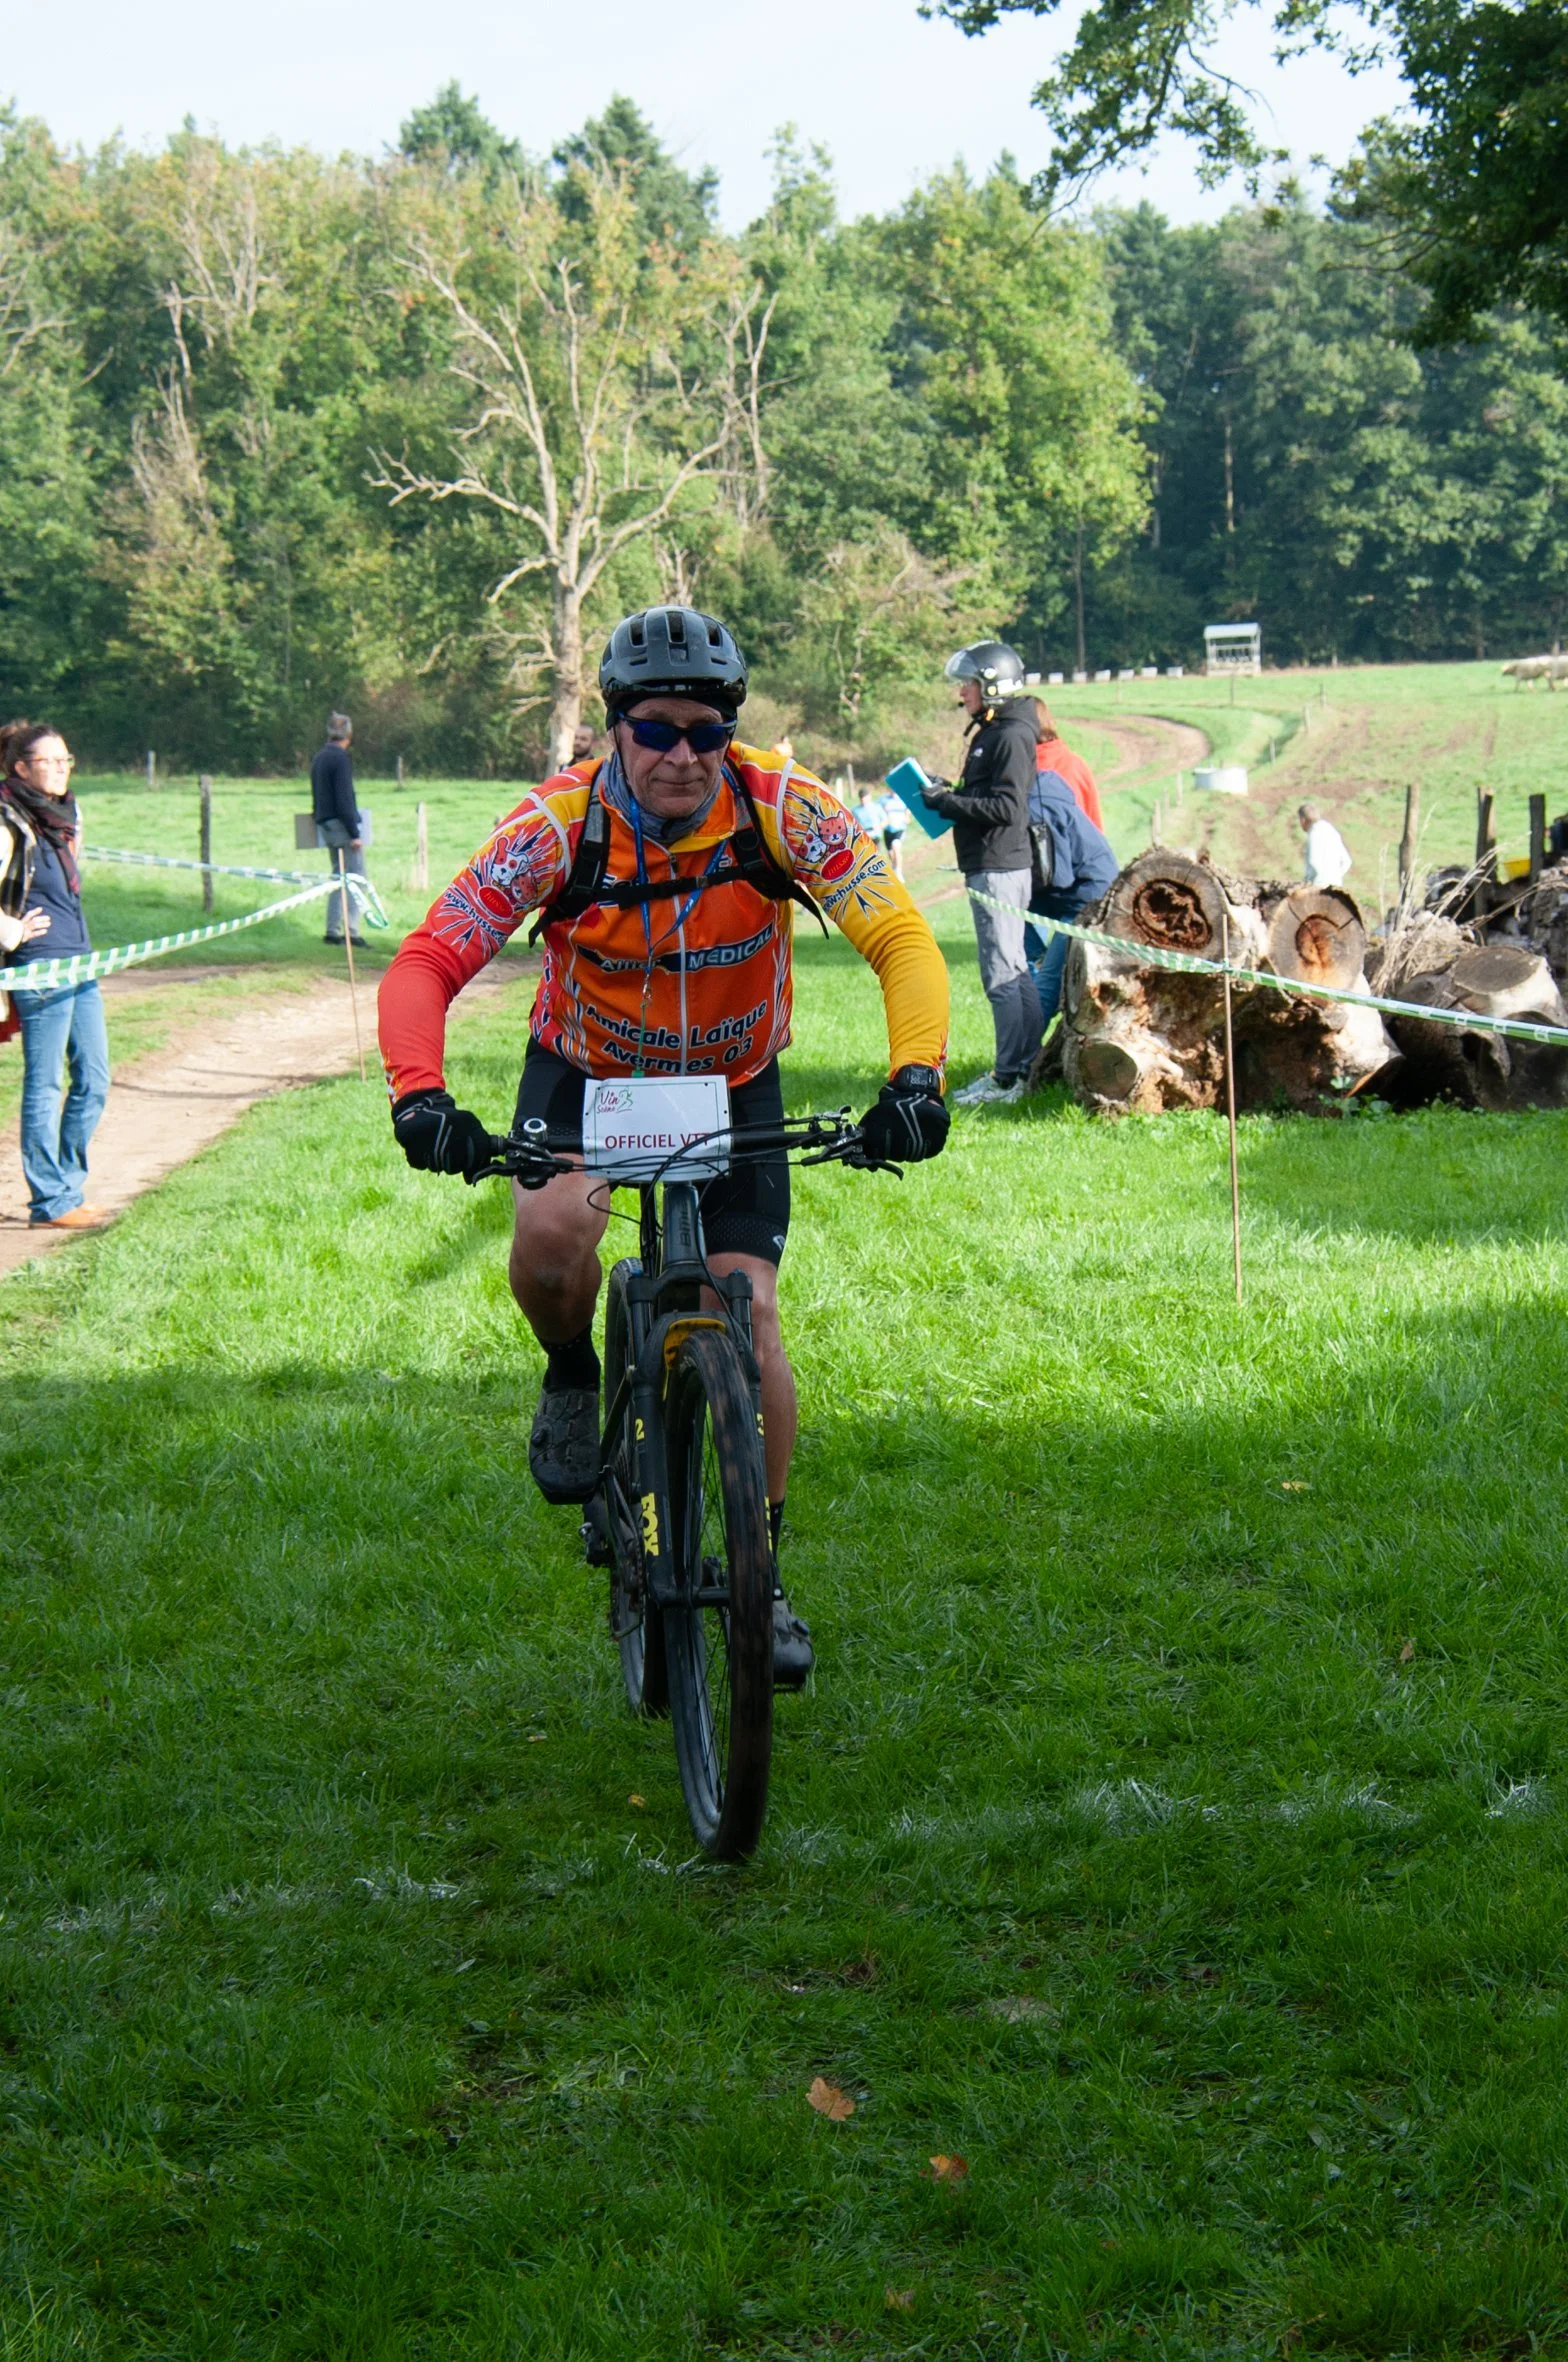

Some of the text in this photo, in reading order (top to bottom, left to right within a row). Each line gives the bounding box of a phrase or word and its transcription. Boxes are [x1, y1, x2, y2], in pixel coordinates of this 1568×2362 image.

[689, 927, 772, 970] MEDICAL
[585, 999, 768, 1050] Amicale Laïque
[601, 1034, 754, 1074] Avermes 03
[604, 1133, 677, 1149] OFFICIEL
